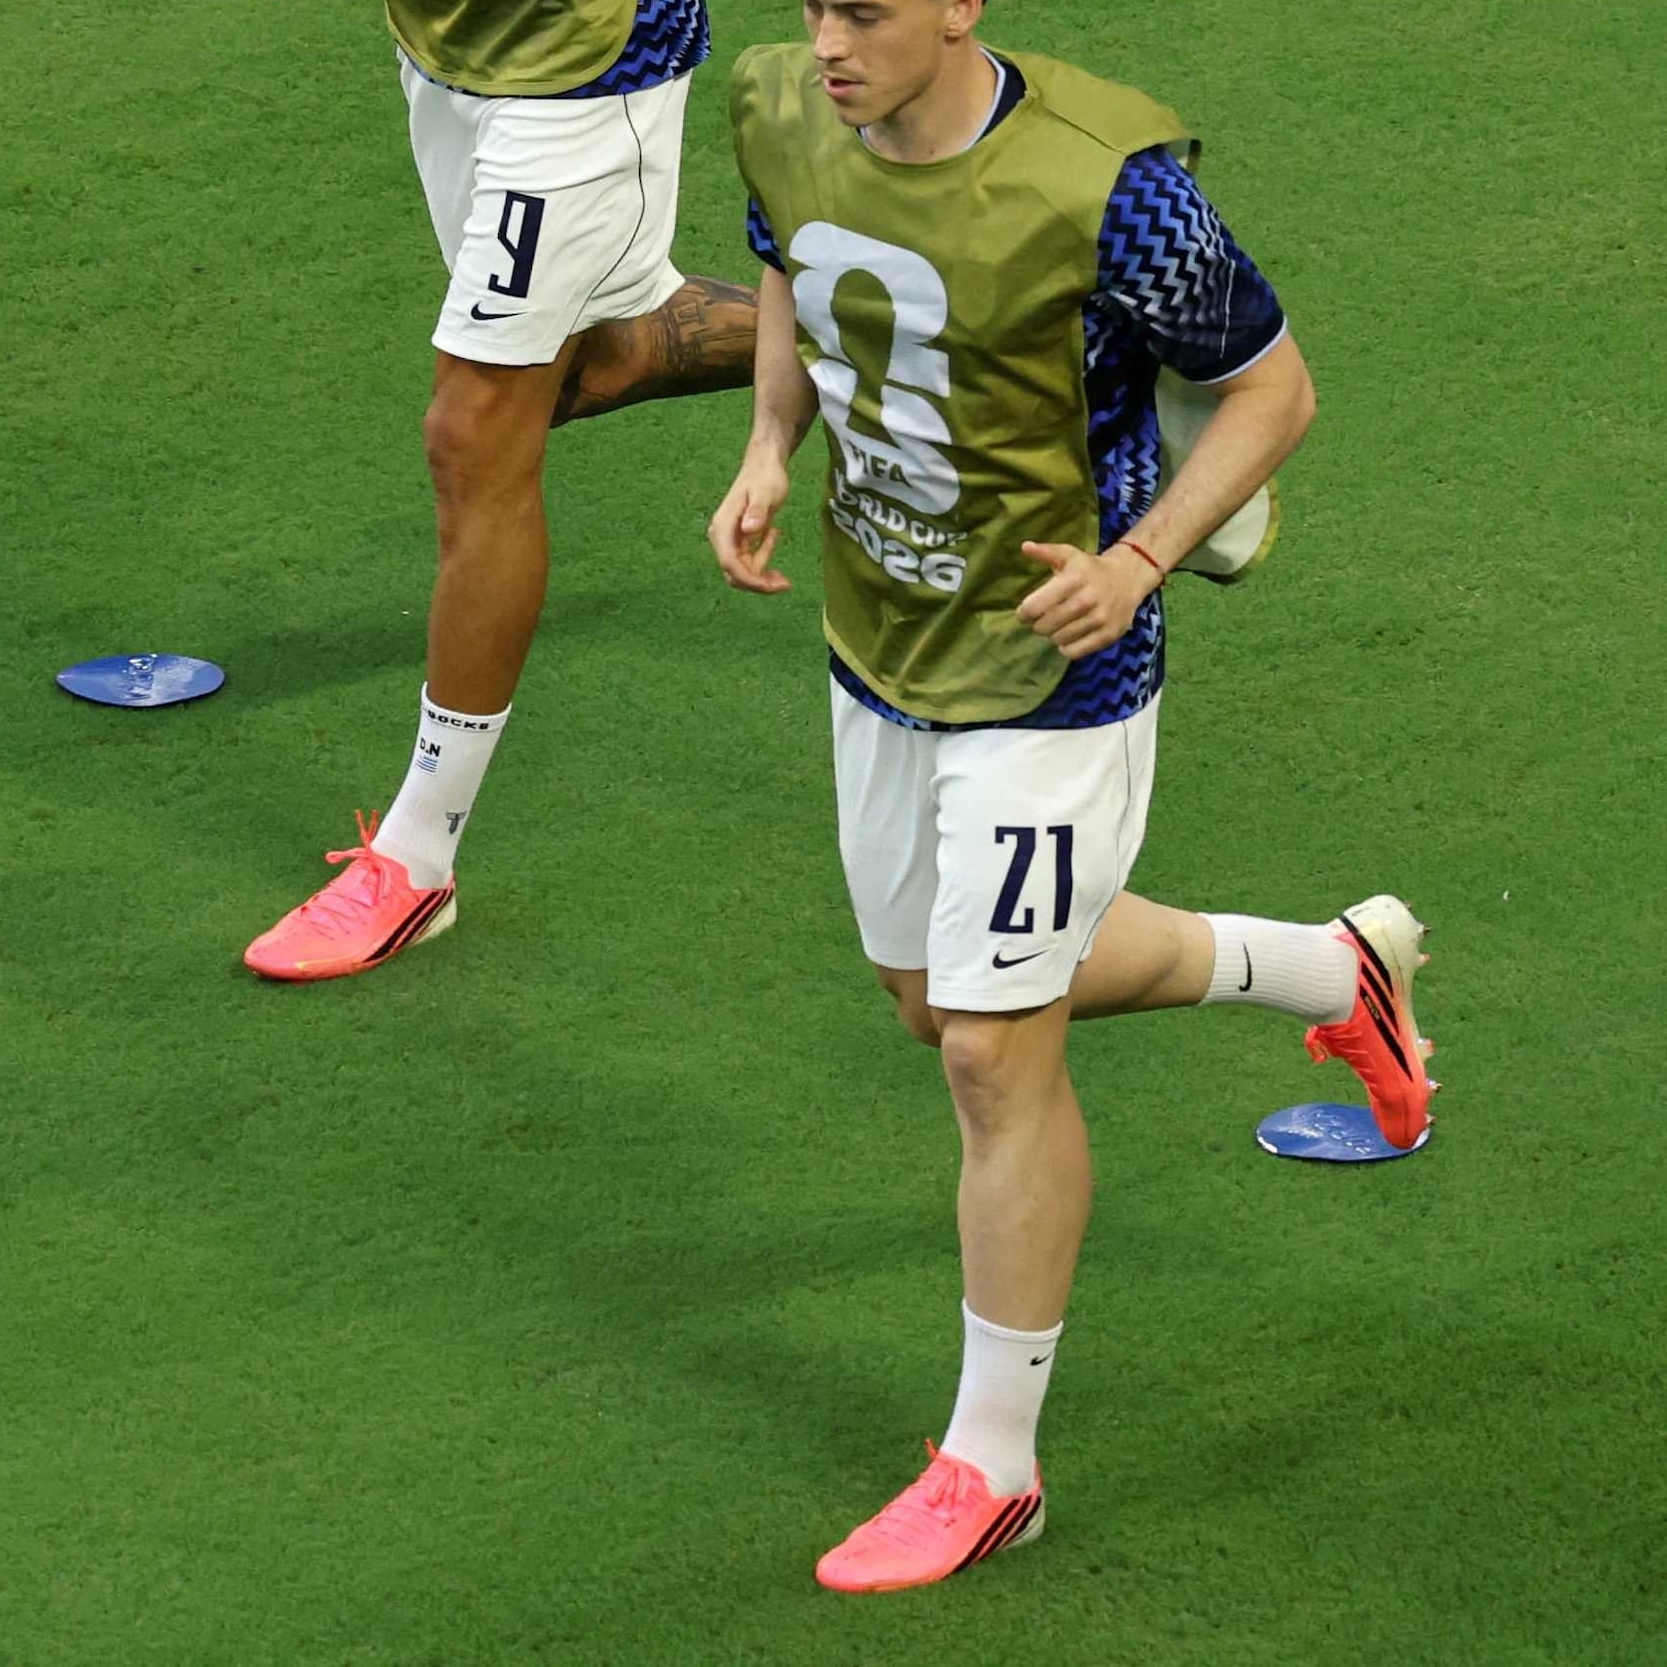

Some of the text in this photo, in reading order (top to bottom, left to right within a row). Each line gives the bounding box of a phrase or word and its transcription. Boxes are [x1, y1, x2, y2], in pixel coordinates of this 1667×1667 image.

[488, 190, 545, 298] 9
[427, 709, 490, 730] SOCKS
[989, 825, 1073, 933] 21
